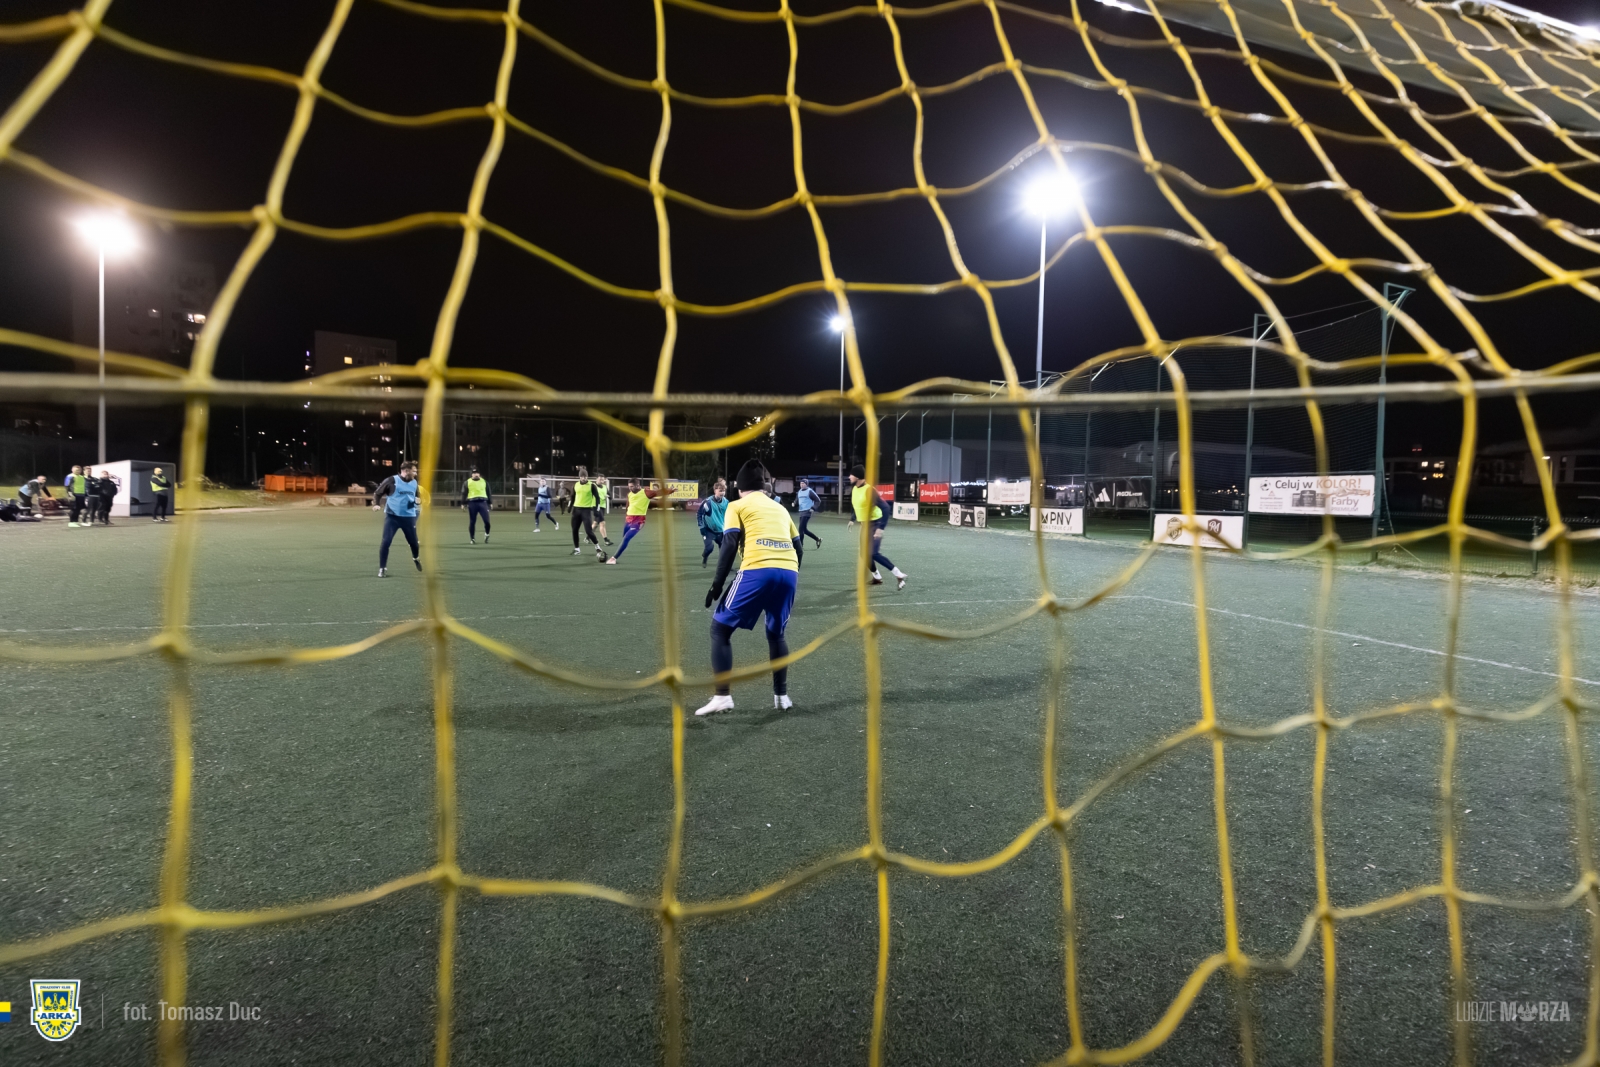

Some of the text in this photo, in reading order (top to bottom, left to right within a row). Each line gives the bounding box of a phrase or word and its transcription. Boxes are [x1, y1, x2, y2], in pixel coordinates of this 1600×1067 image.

[1275, 478, 1362, 491] Celuj w KOLOR!
[1331, 496, 1359, 508] Farby
[1050, 512, 1072, 525] PNV
